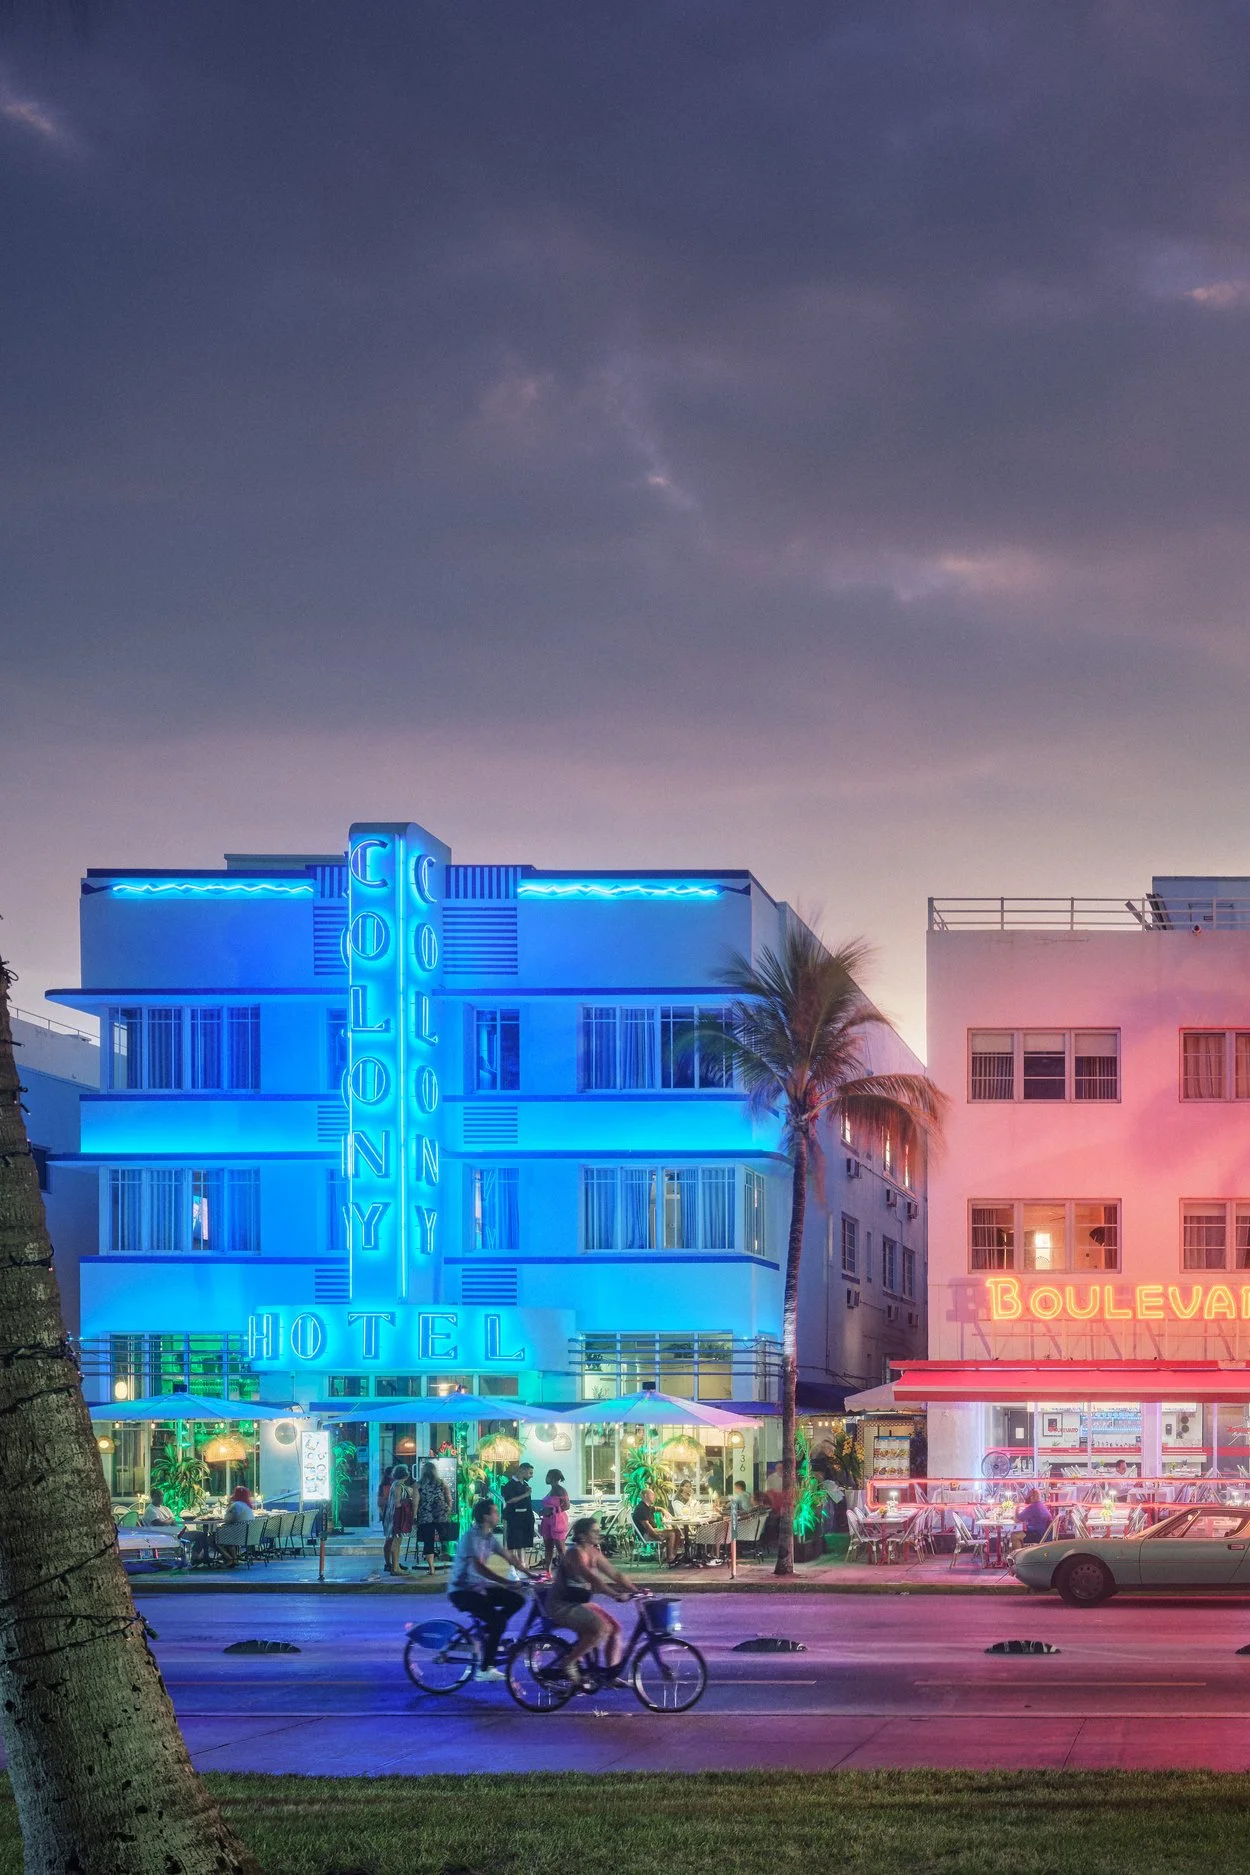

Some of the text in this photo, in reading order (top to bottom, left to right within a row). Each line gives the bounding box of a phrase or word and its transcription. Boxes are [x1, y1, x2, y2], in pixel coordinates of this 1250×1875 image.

[349, 840, 390, 1250] COLONY
[414, 855, 439, 1255] COLONY
[249, 1311, 525, 1361] HOTEL
